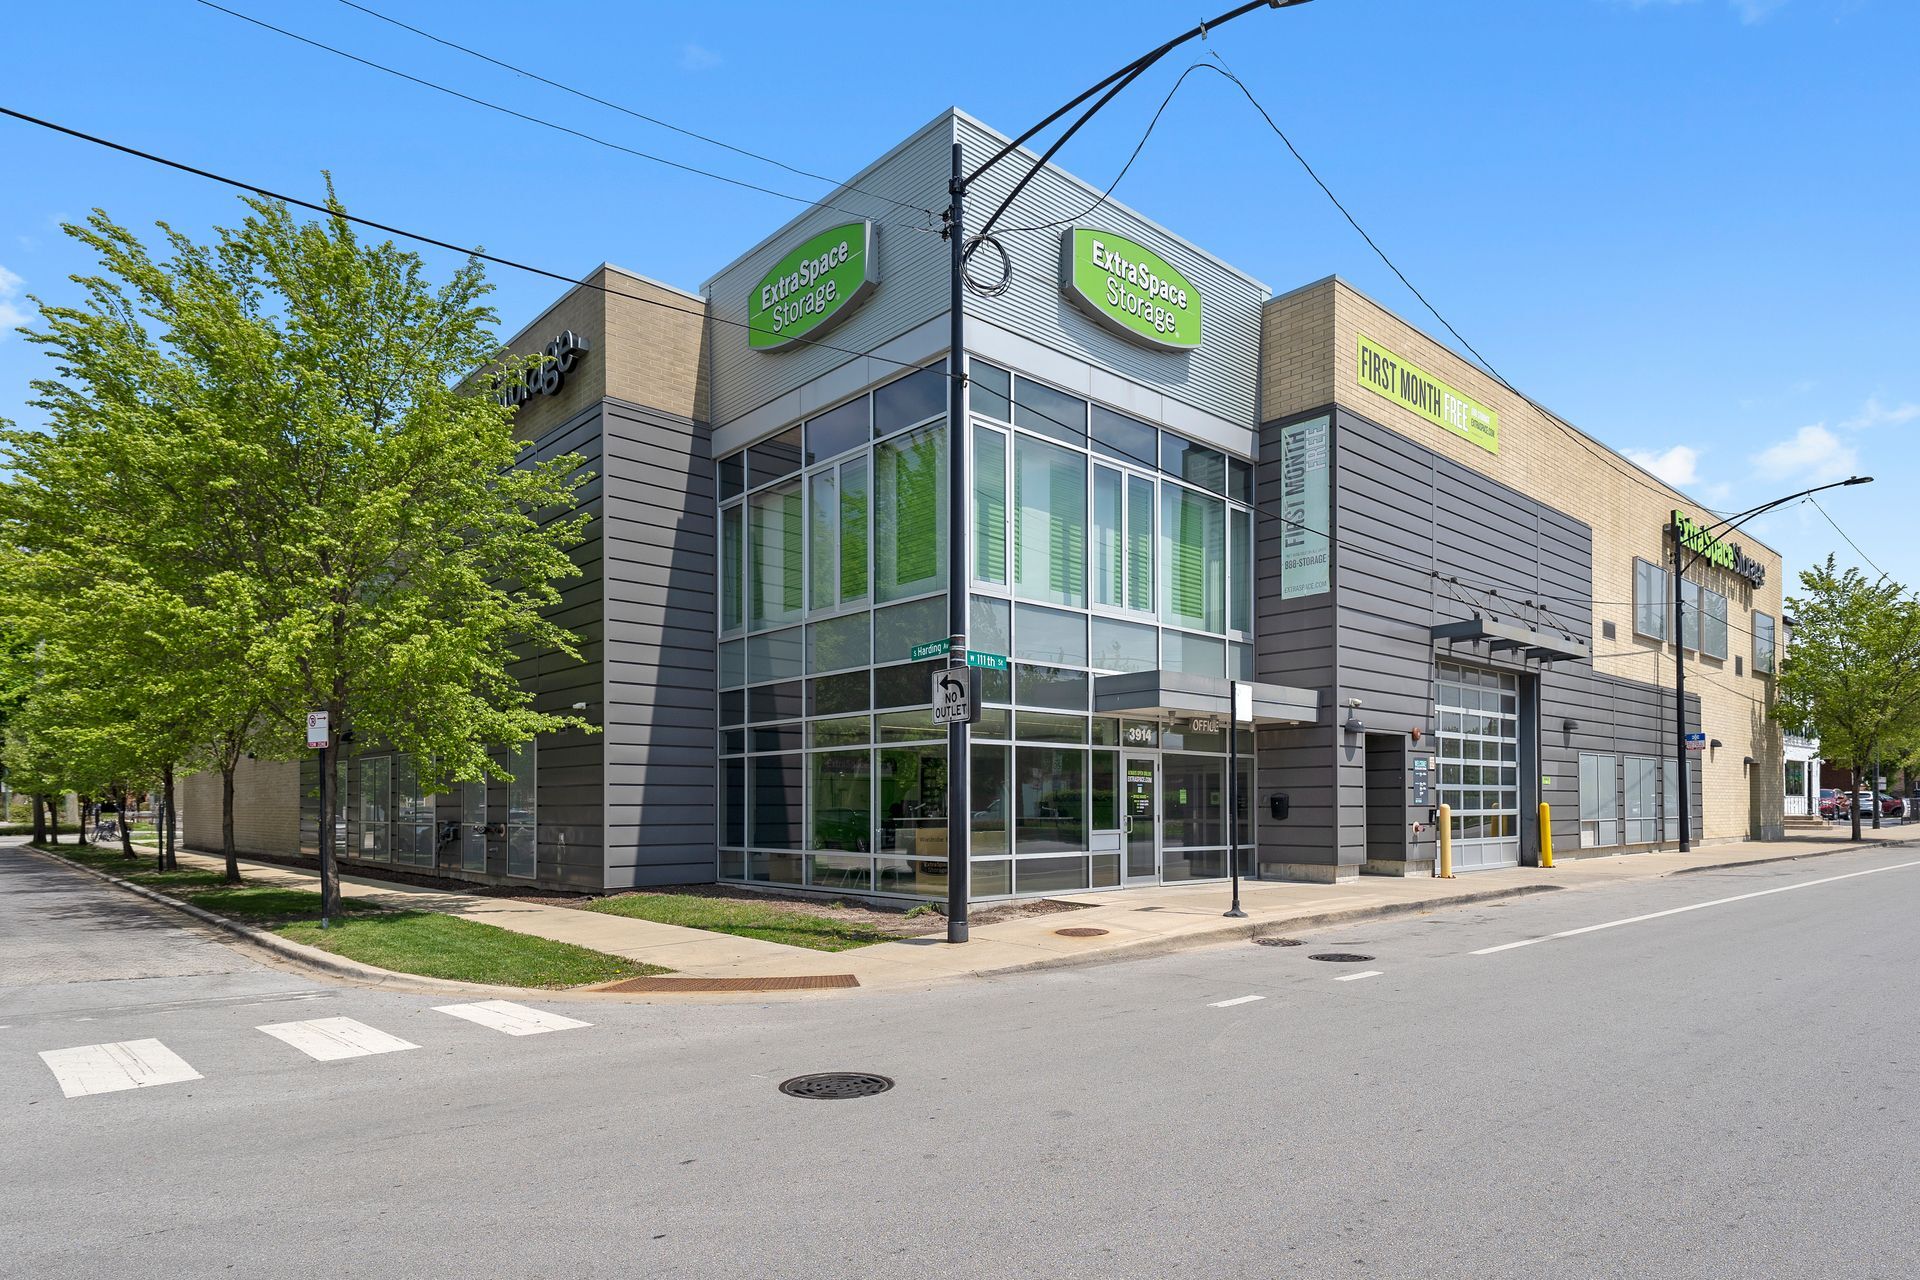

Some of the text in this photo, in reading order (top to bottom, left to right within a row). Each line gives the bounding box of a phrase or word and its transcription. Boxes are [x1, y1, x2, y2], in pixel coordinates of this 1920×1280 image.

[762, 240, 848, 311] ExtraSpace
[1092, 239, 1187, 309] ExtraSpace
[773, 279, 836, 332] Storage
[1106, 276, 1175, 333] Storage
[1361, 345, 1469, 432] FIRST MONTH FREE
[1305, 424, 1327, 472] FREE
[1284, 430, 1305, 548] FIRST MONTH
[1284, 554, 1327, 570] 888-STORAGE
[917, 643, 942, 657] Harding
[976, 654, 996, 667] 111th
[997, 658, 1004, 666] St
[936, 703, 967, 718] OUTLET
[945, 692, 957, 704] NO
[1129, 728, 1152, 741] 3914
[1192, 719, 1219, 733] OFFICE
